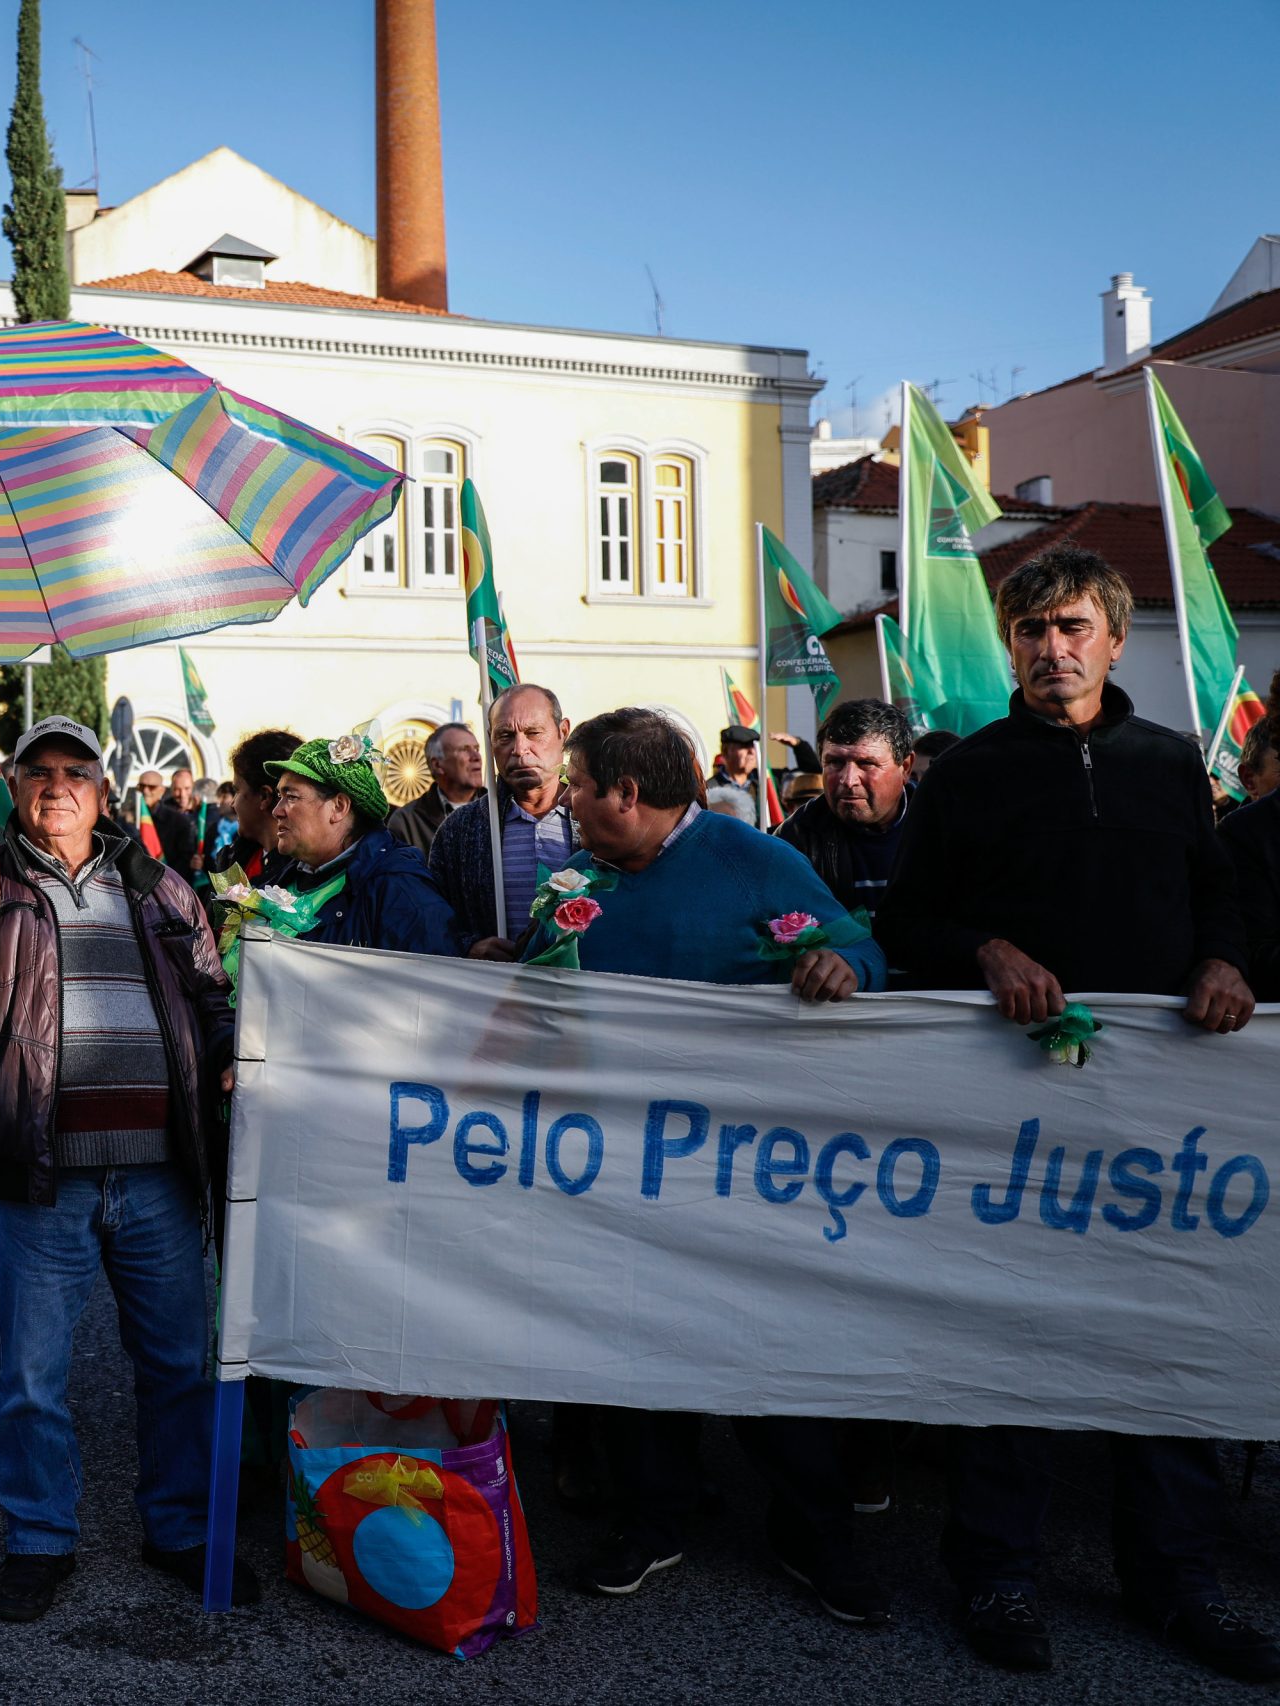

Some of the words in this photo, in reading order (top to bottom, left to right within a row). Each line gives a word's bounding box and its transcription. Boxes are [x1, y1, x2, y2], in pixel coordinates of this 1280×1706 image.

[387, 1081, 605, 1197] Pelo
[640, 1098, 942, 1244] Preço
[970, 1117, 1271, 1240] Justo
